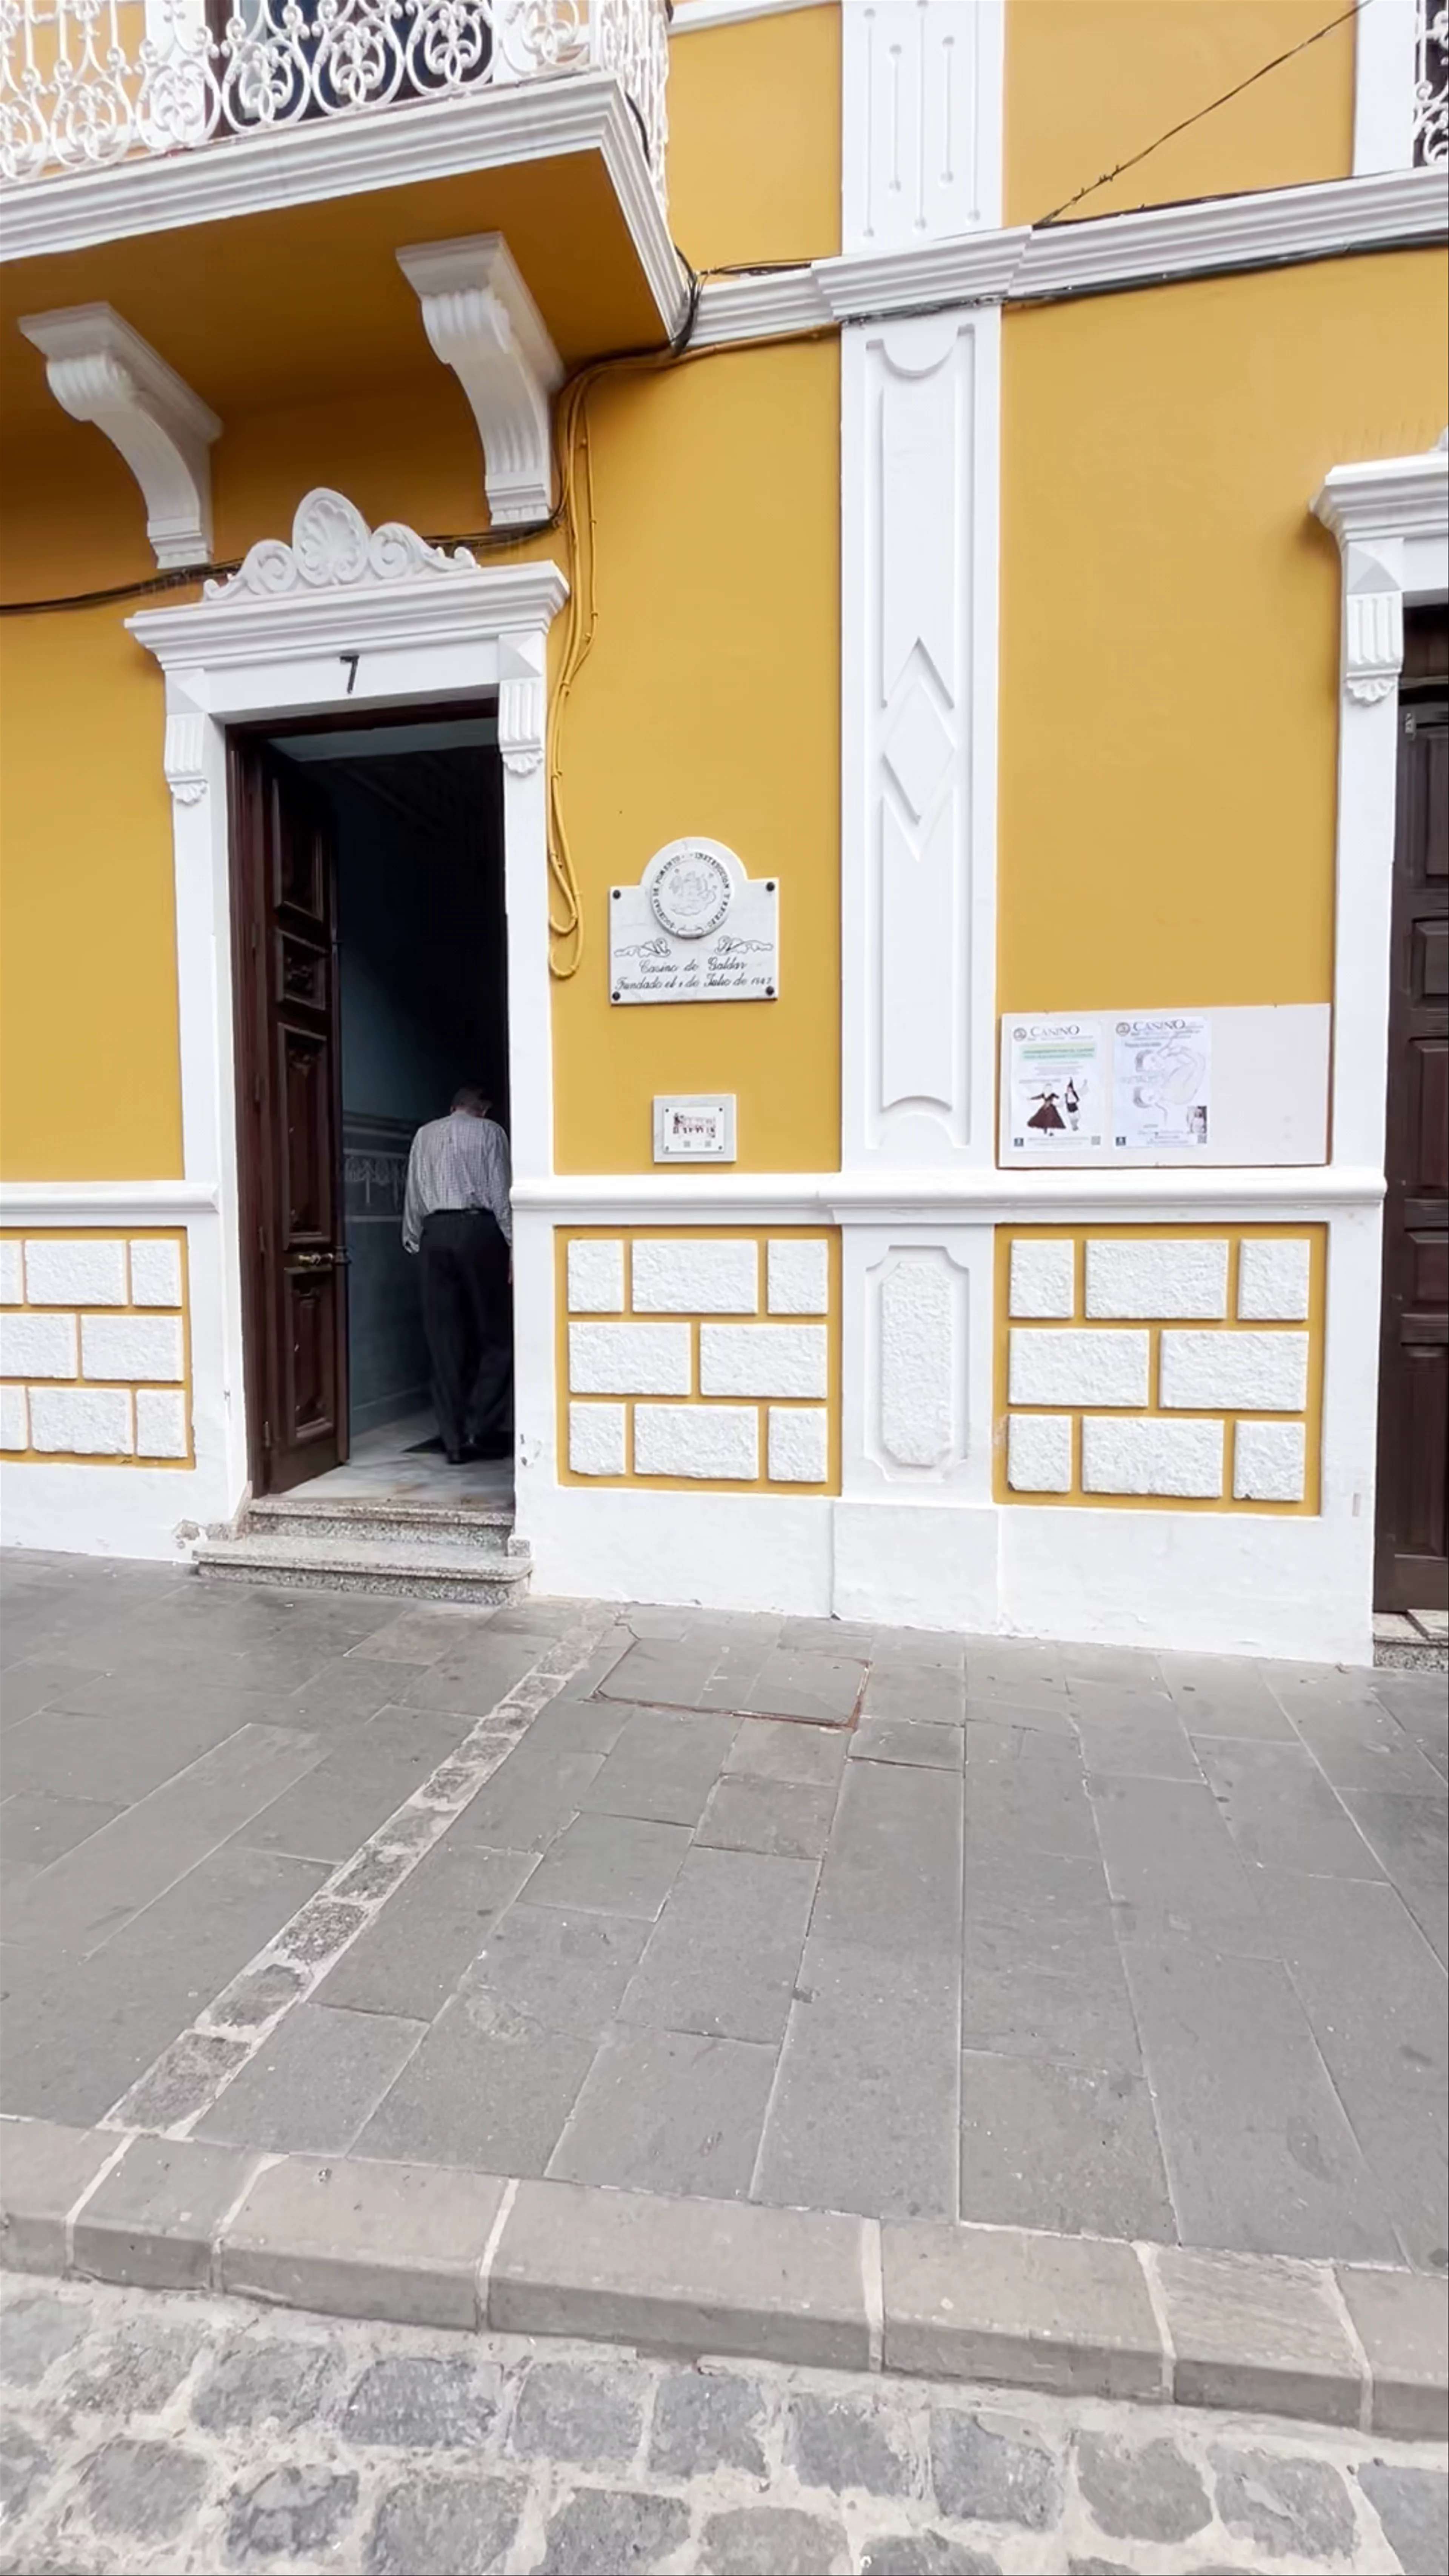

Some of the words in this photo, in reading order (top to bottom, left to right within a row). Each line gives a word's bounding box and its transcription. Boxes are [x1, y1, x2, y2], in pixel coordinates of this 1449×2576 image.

[340, 655, 360, 694] 7
[639, 959, 679, 973] Casino
[683, 958, 699, 971] de
[615, 976, 662, 990] Fundado
[665, 975, 678, 988] el
[684, 975, 699, 987] de
[733, 972, 748, 986] de
[1030, 1024, 1080, 1037] CASINO
[1133, 1019, 1186, 1032] CASINO
